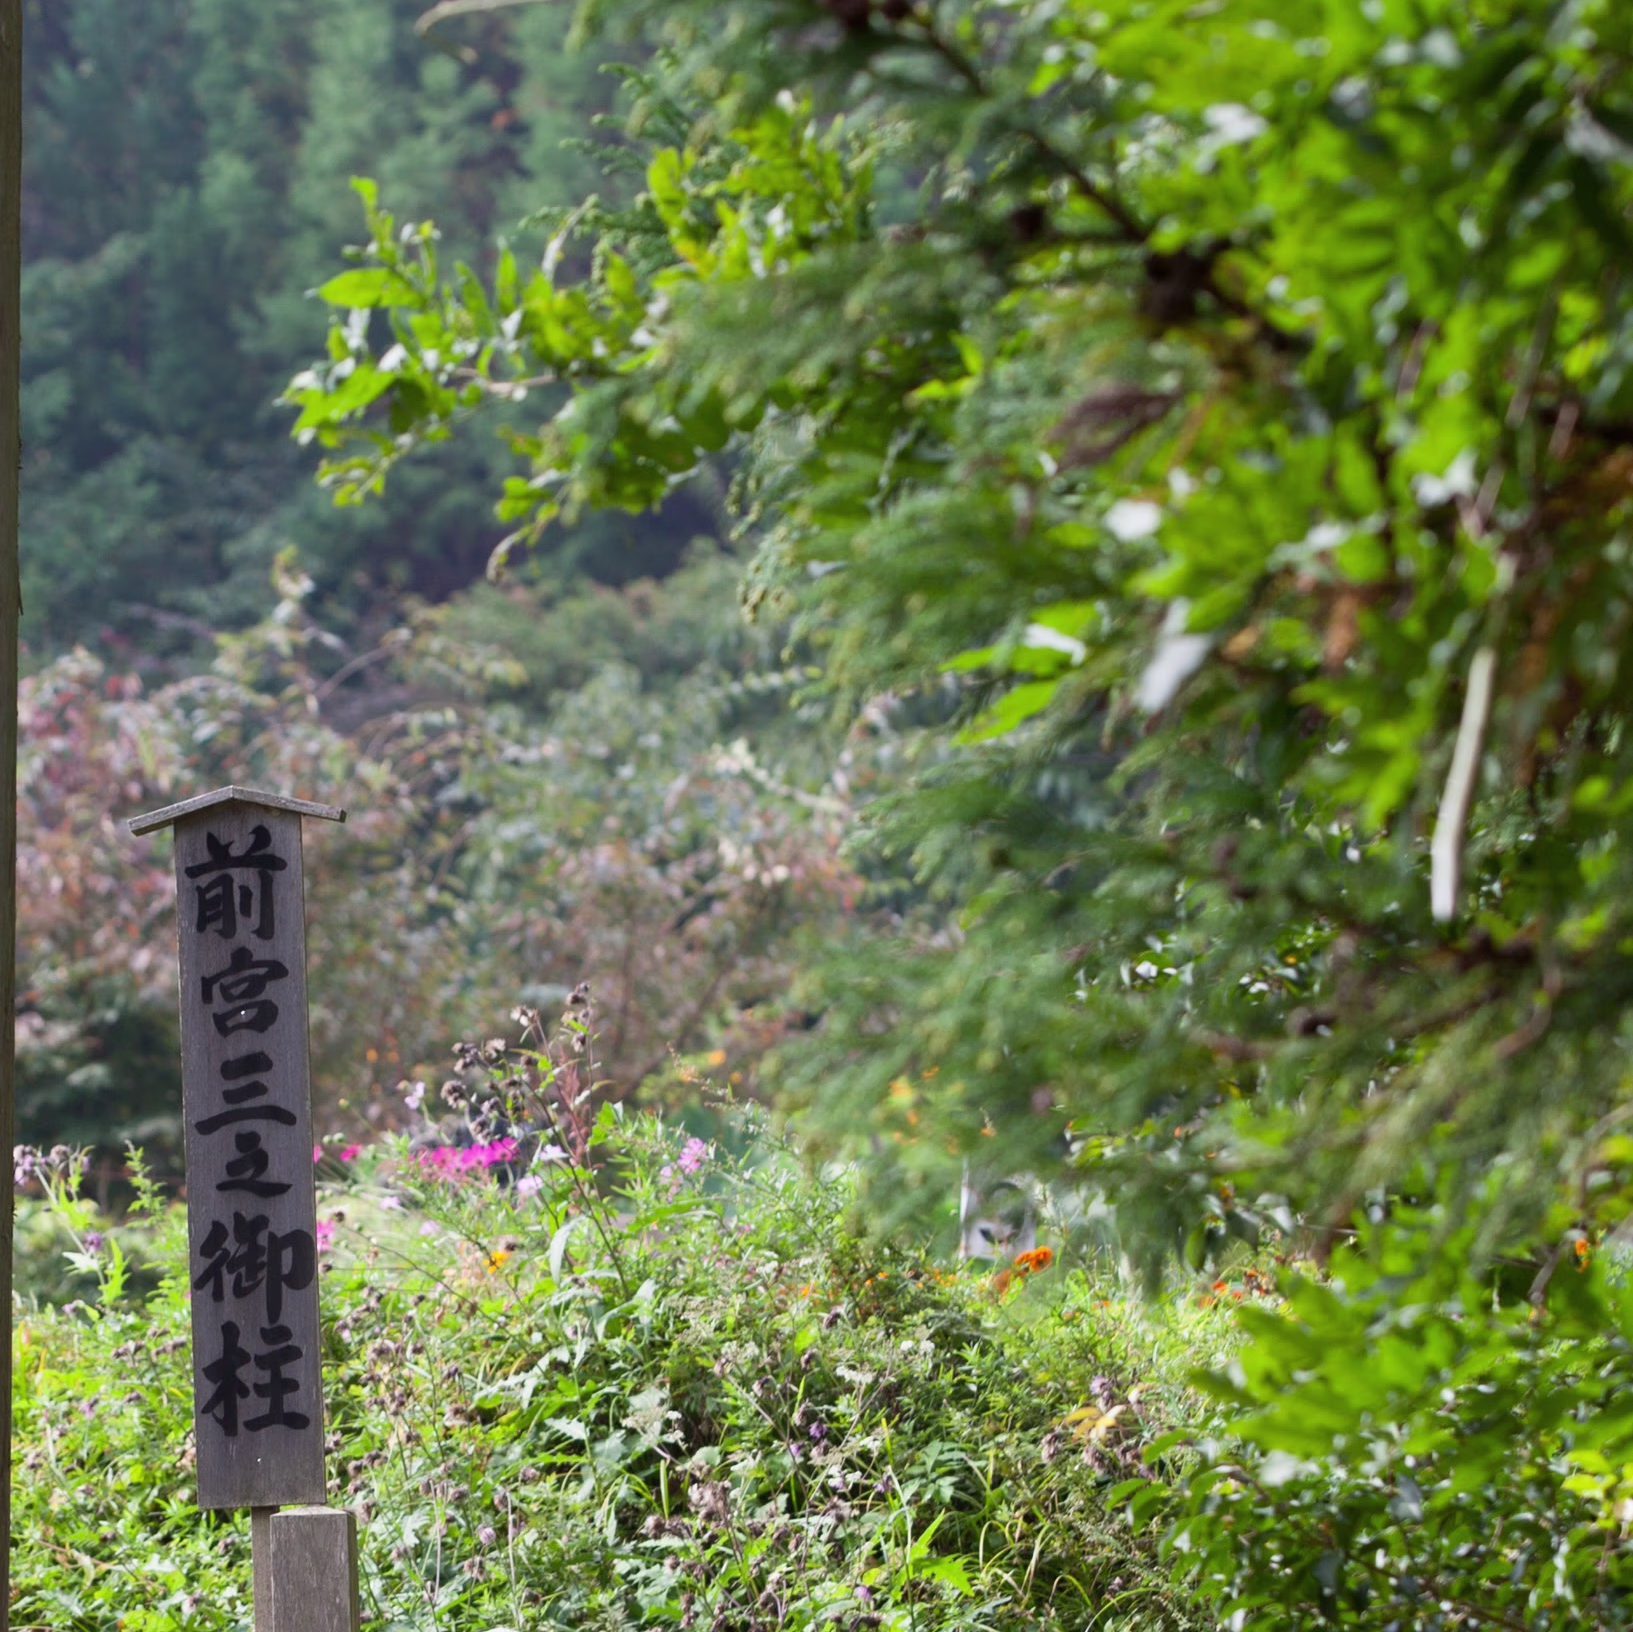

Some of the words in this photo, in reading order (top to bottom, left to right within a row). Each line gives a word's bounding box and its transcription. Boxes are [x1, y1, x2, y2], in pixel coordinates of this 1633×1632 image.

[186, 825, 315, 1437] 前宮三之御柱
